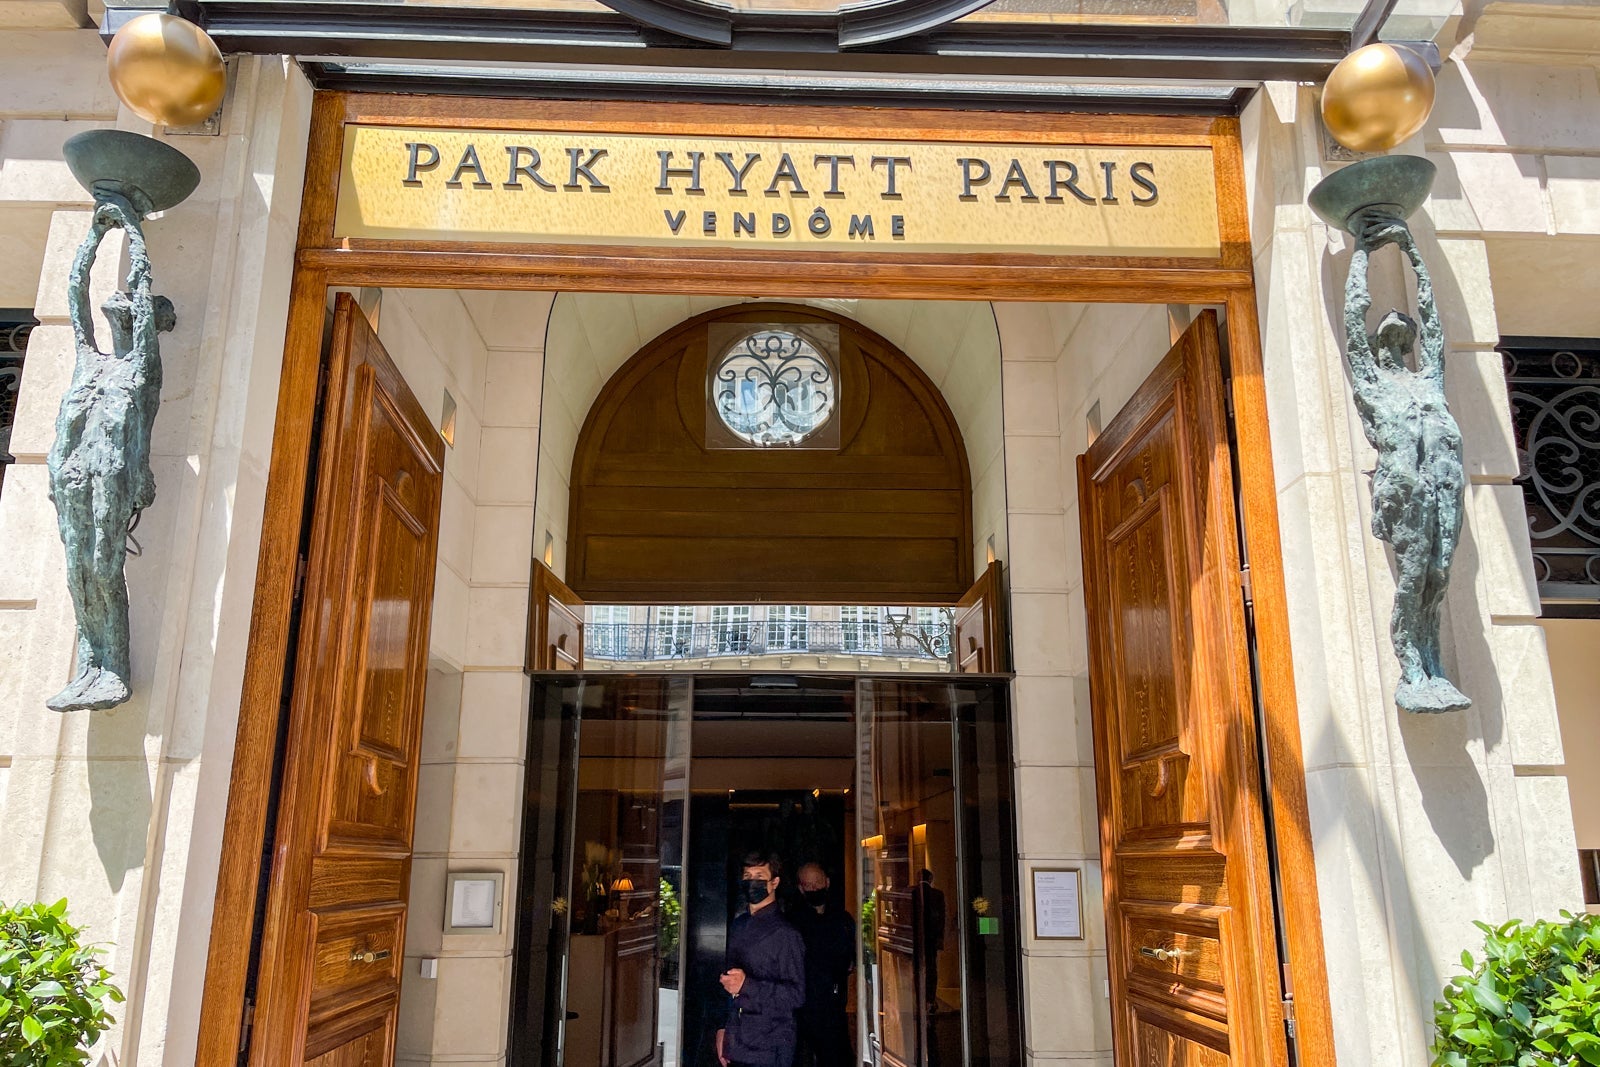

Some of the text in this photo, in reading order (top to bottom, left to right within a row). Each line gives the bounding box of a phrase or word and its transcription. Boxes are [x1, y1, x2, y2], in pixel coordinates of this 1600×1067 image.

[402, 143, 1158, 205] PARK HYATT PARIS
[664, 206, 905, 239] VENDÔME
